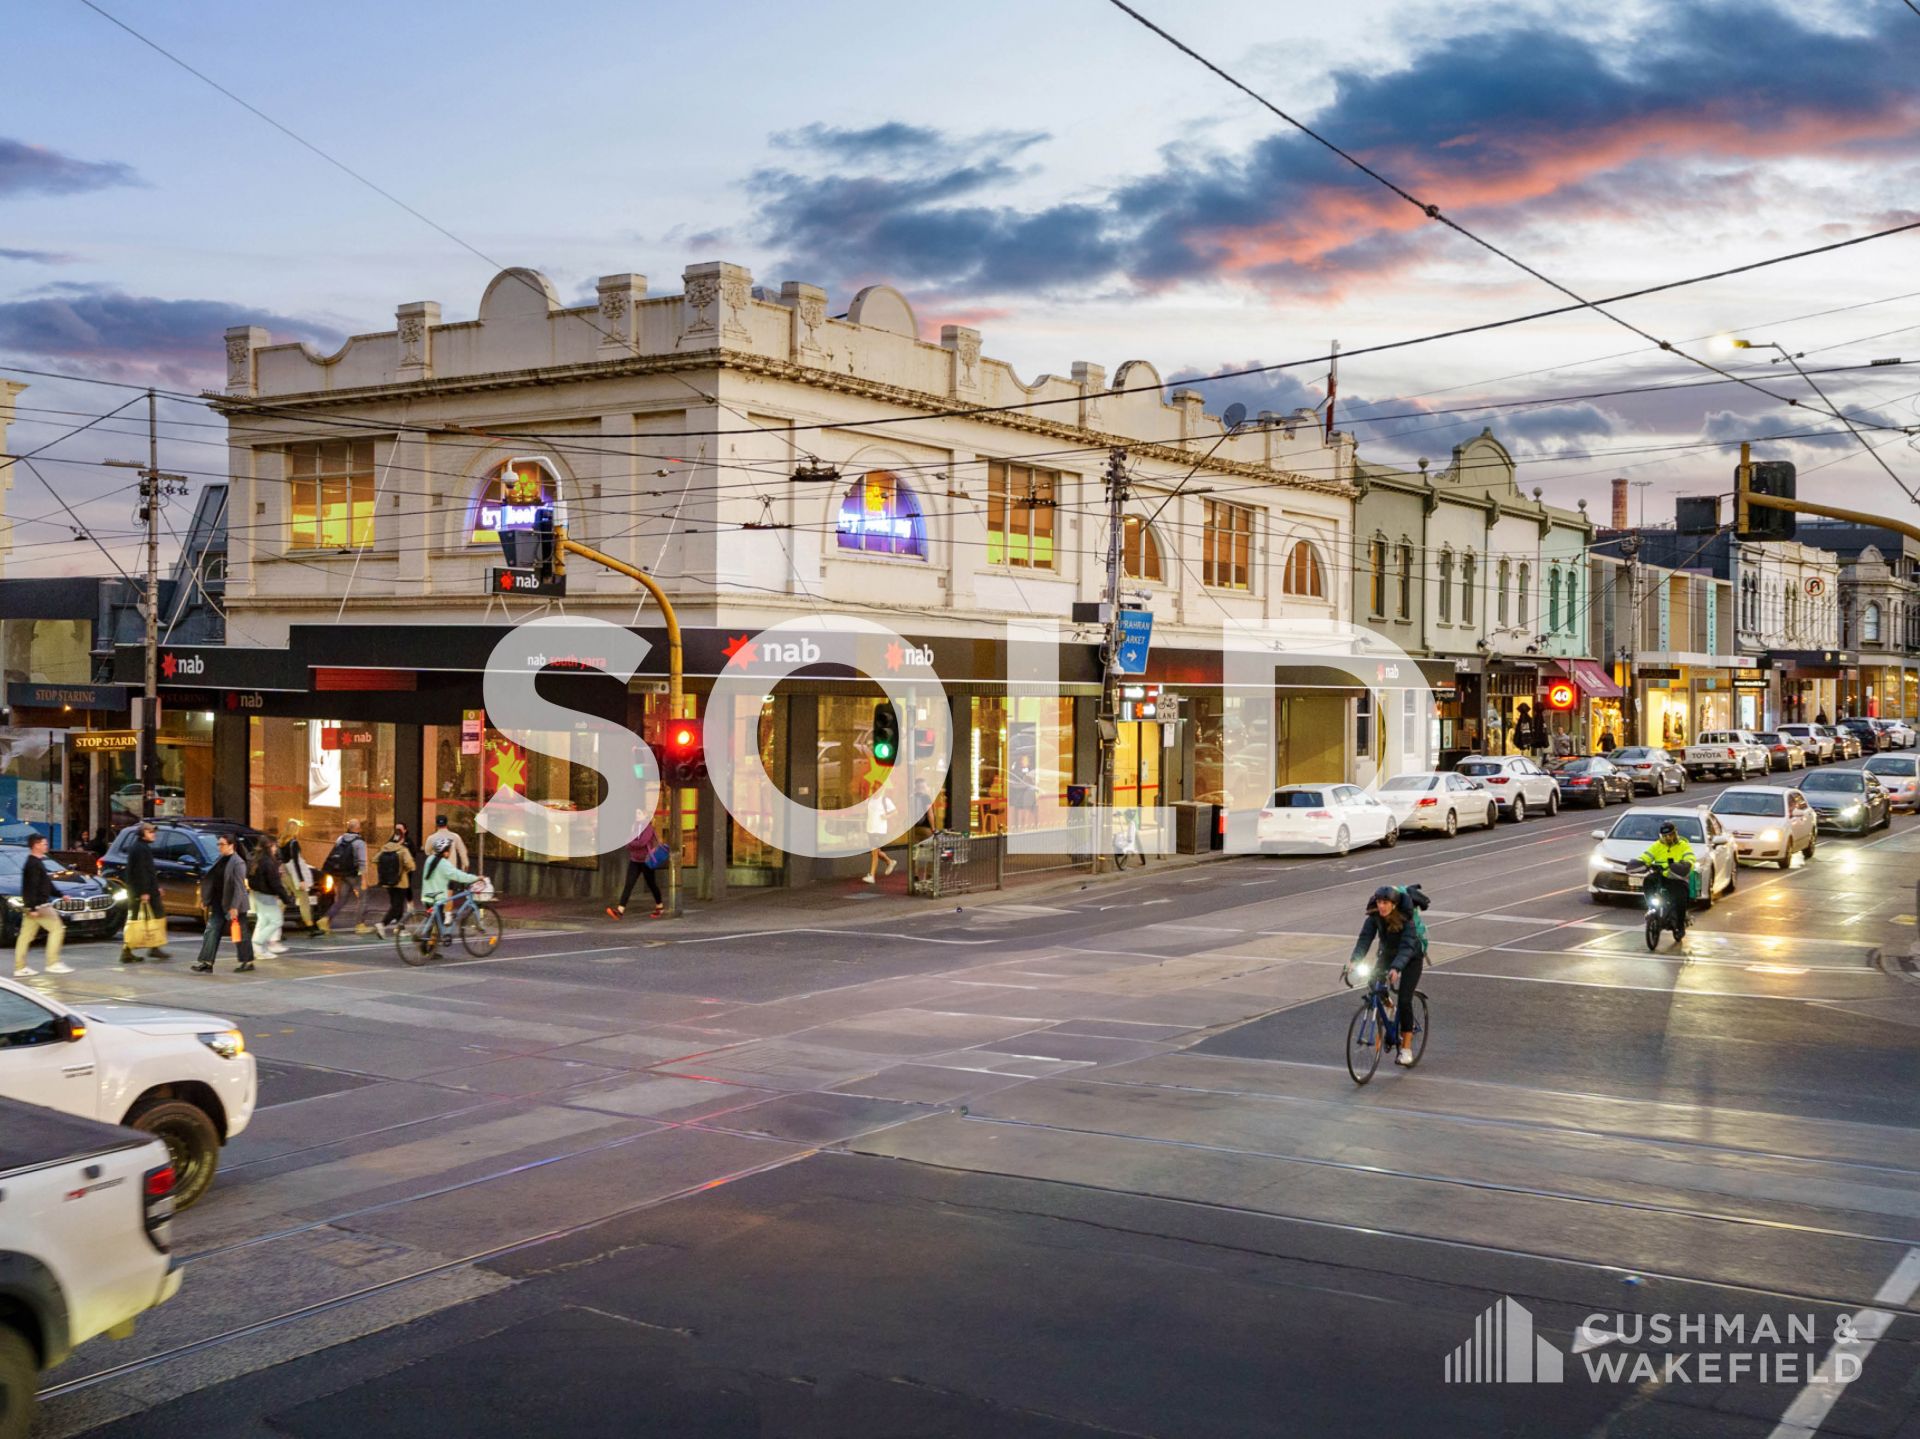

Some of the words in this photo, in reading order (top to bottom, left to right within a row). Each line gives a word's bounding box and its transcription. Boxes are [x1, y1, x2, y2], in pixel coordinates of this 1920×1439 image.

[515, 574, 539, 588] nab
[1120, 620, 1151, 630] PRAHRAN
[1125, 634, 1146, 645] ARKET
[762, 637, 821, 663] nab
[904, 644, 934, 666] nab
[177, 654, 204, 674] nab
[527, 653, 546, 666] nab
[549, 653, 578, 667] south
[580, 656, 606, 669] yarra
[1385, 664, 1399, 679] nab
[35, 689, 58, 701] STOP
[59, 690, 96, 703] STARING
[240, 692, 263, 708] nab
[1554, 690, 1569, 702] 40
[1158, 711, 1176, 720] LANE
[76, 737, 102, 748] STOP
[103, 736, 138, 747] STARIN
[353, 732, 372, 743] nab
[1692, 751, 1721, 759] TOYOTA
